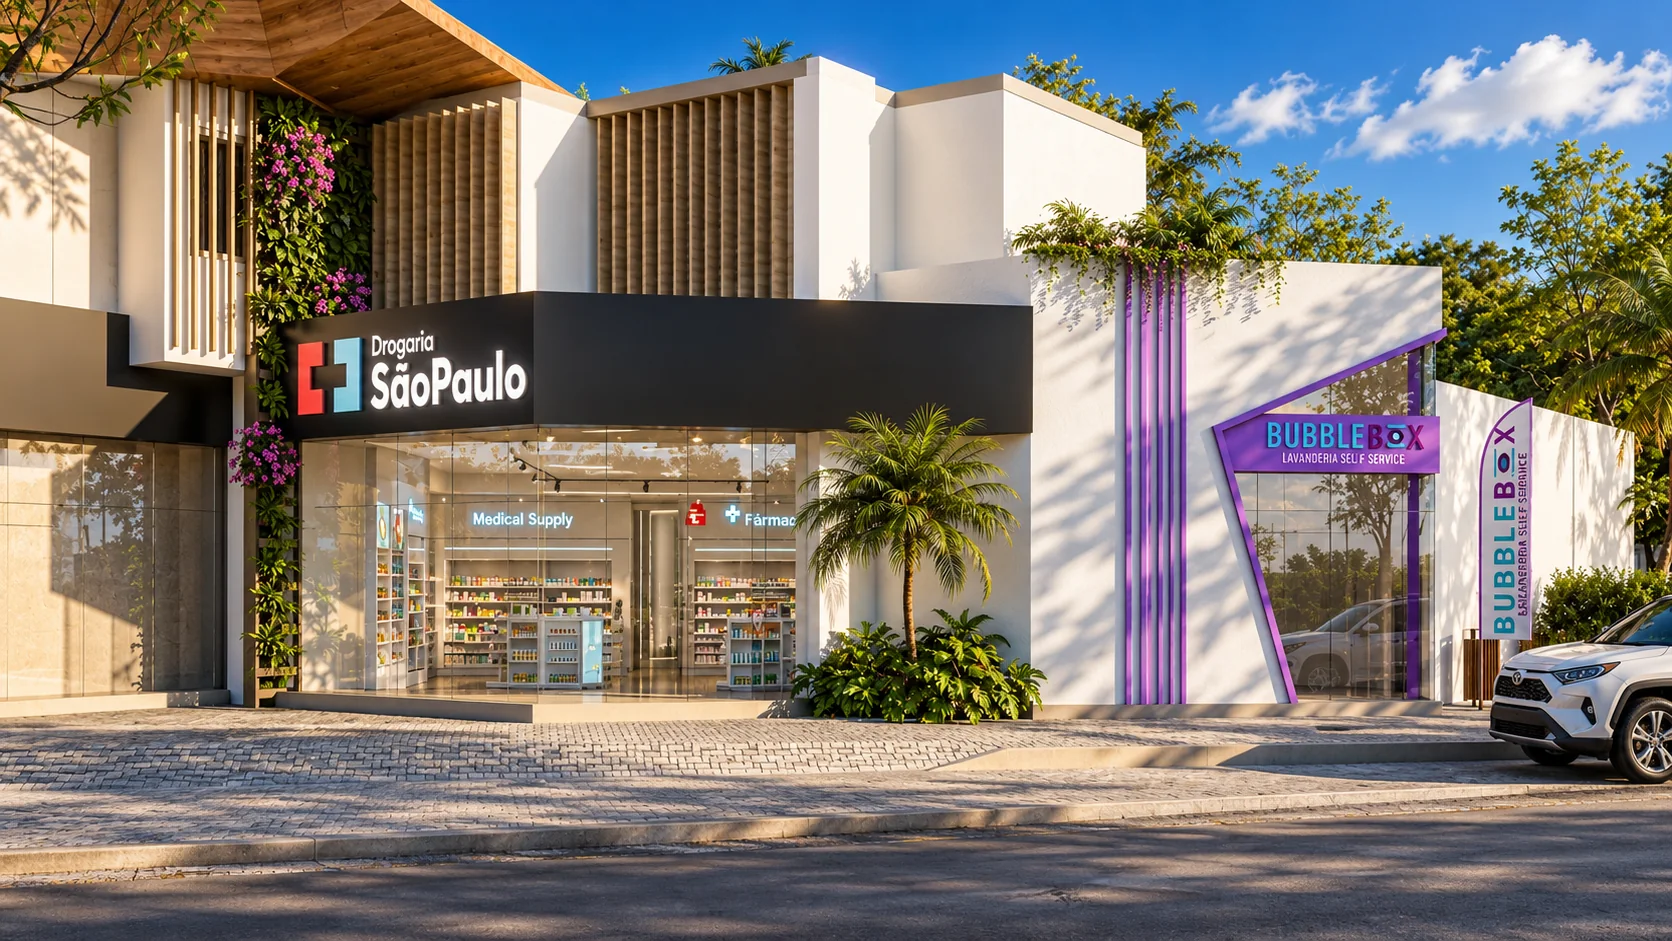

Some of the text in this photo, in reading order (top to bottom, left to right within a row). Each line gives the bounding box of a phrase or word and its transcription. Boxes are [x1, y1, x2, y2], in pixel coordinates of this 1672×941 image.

[371, 330, 434, 359] Drogaria
[370, 350, 527, 410] SãoPaulo
[1267, 421, 1425, 450] BUBBLEBOX
[1282, 452, 1338, 464] LAVANDERIA
[1368, 453, 1406, 465] SERVICE
[473, 511, 574, 529] Medical Supply
[1493, 426, 1515, 634] BUBBLEBOX
